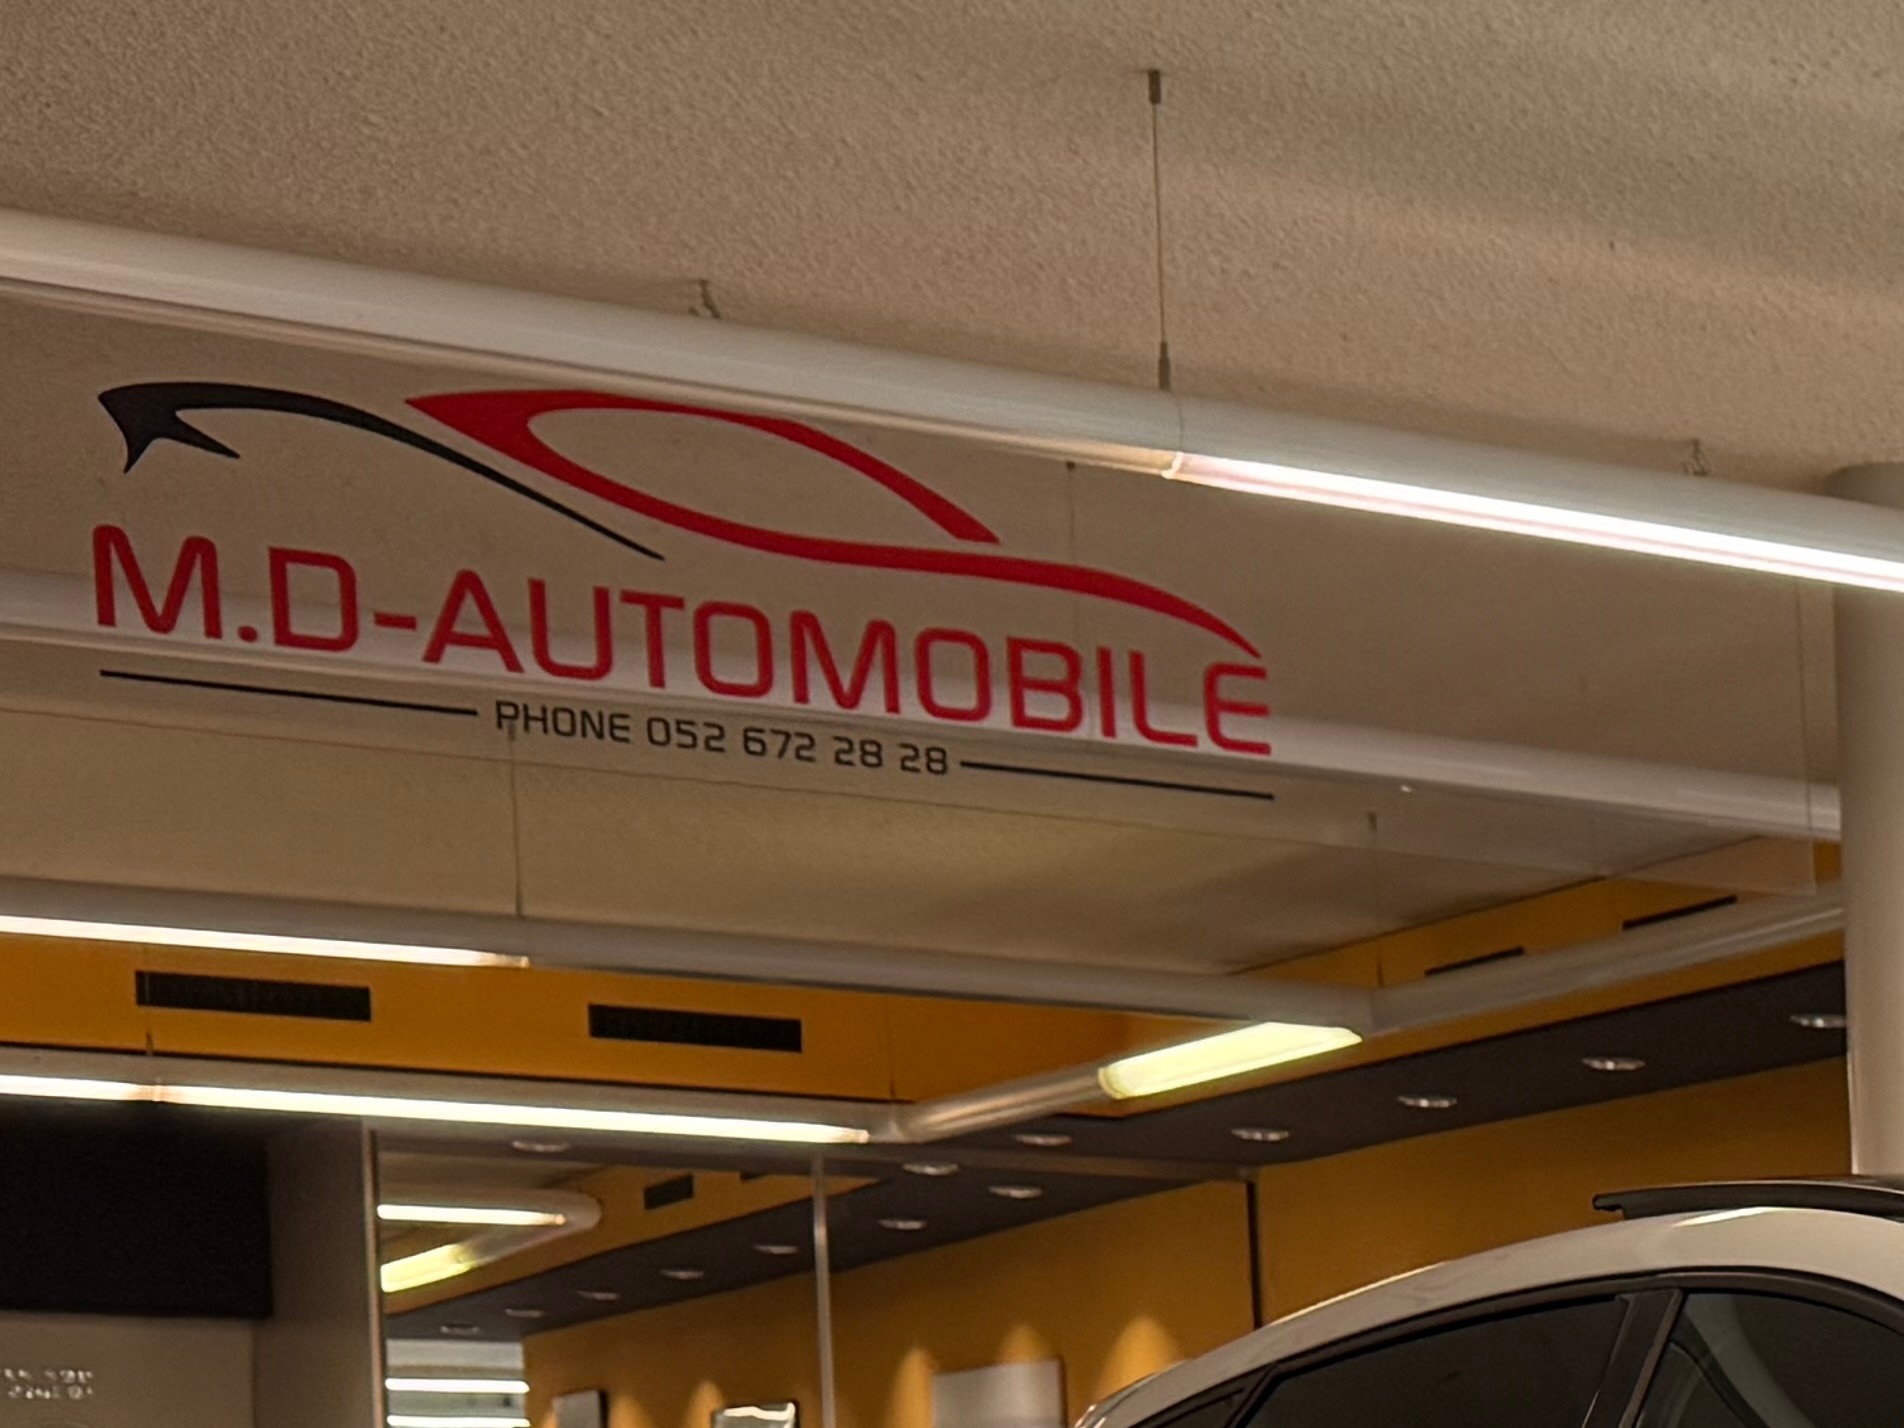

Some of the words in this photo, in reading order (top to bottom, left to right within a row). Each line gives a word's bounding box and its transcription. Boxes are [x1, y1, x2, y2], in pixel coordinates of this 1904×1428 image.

[92, 522, 1273, 758] M.D-AUTOMOBILE
[495, 699, 632, 744] PHONE
[646, 715, 727, 754] 052
[742, 725, 818, 764] 672
[833, 734, 885, 769] 28
[899, 742, 949, 776] 28
